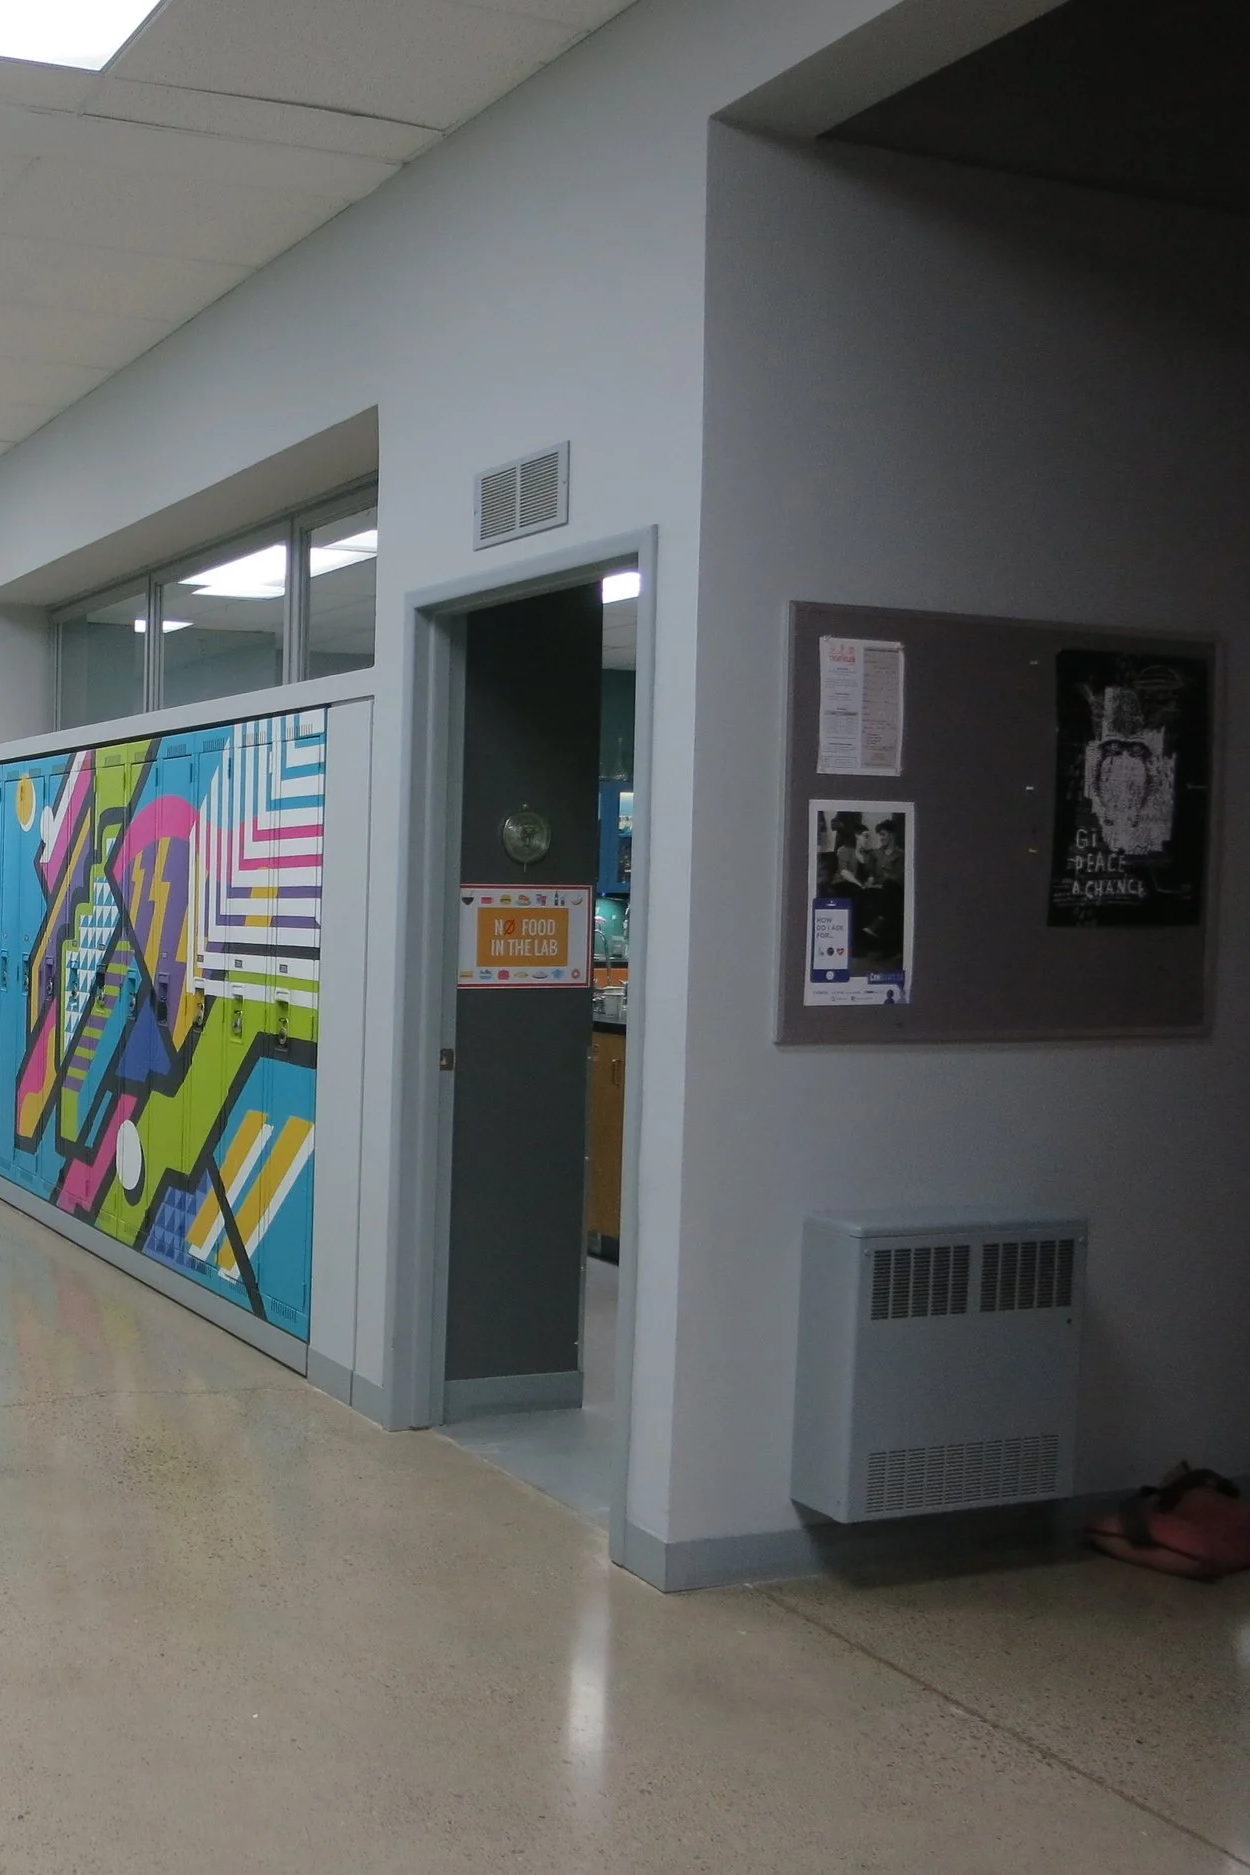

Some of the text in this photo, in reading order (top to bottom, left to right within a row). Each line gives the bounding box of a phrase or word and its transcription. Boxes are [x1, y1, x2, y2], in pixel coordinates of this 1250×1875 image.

[1074, 852, 1127, 875] PEACE
[522, 918, 556, 936] FOOD
[491, 939, 558, 956] IN THE LAB
